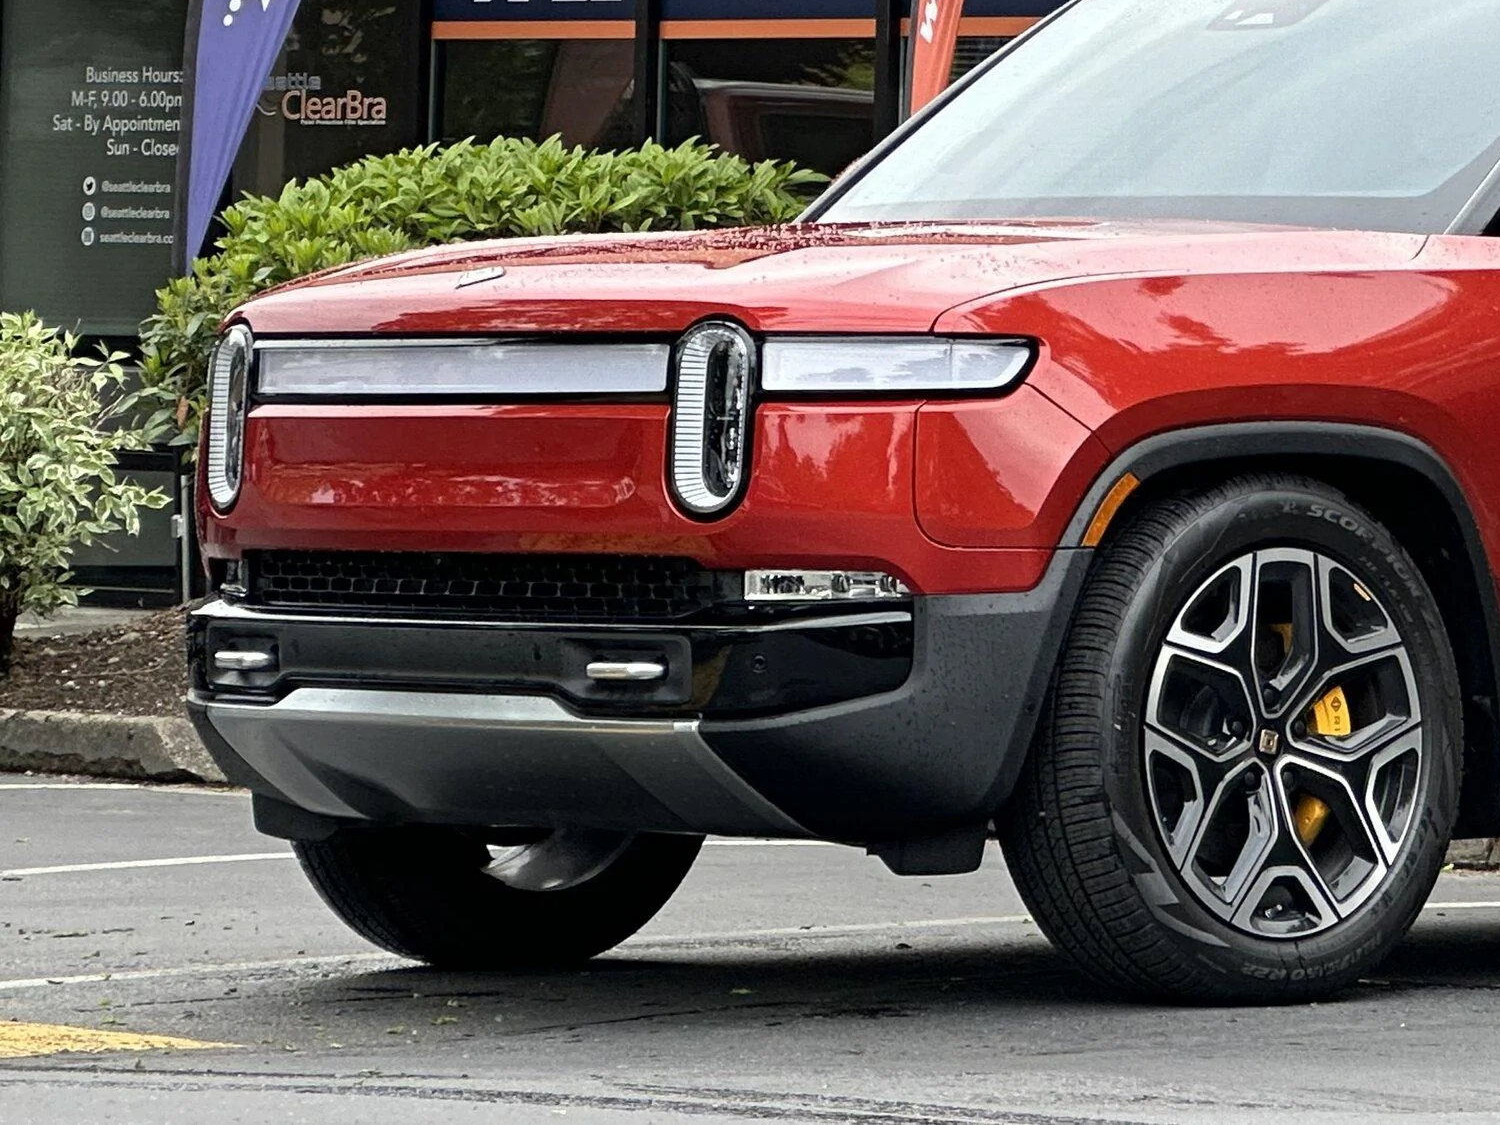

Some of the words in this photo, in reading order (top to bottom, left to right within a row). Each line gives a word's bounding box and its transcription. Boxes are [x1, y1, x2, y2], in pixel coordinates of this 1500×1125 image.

[86, 66, 138, 83] Business
[142, 66, 183, 83] Hours:
[71, 90, 98, 109] M-F,
[101, 90, 128, 107] 9.00
[281, 89, 387, 120] ClearBra
[53, 114, 73, 131] Sat
[84, 114, 100, 136] By
[102, 115, 180, 136] Appointmen
[106, 139, 130, 155] Sun
[141, 138, 179, 156] Close
